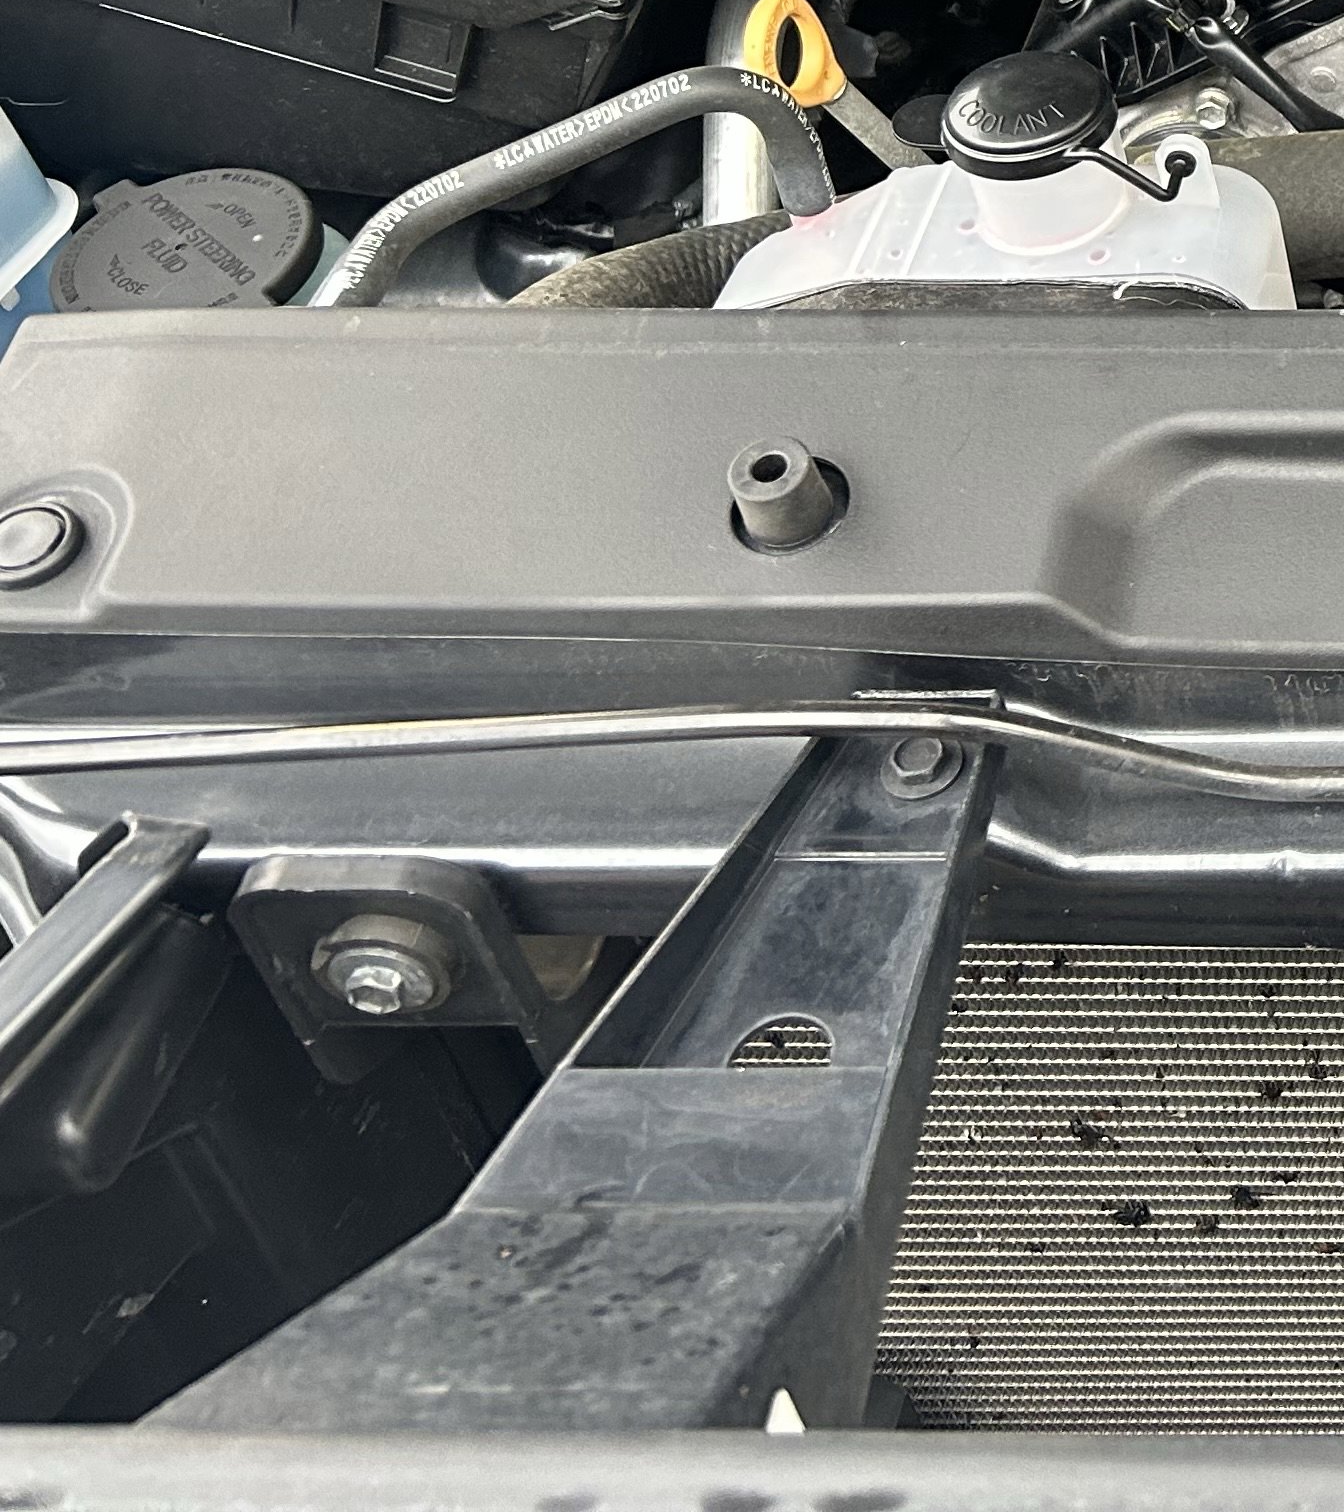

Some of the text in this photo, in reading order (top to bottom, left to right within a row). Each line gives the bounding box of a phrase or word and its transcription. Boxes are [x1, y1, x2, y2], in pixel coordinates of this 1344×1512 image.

[958, 100, 1065, 136] COOLANT
[223, 203, 256, 229] OPEN
[142, 192, 196, 236] POWER
[185, 227, 256, 286] STEERING
[142, 238, 189, 274] FLUID
[107, 266, 150, 296] CLOSE
